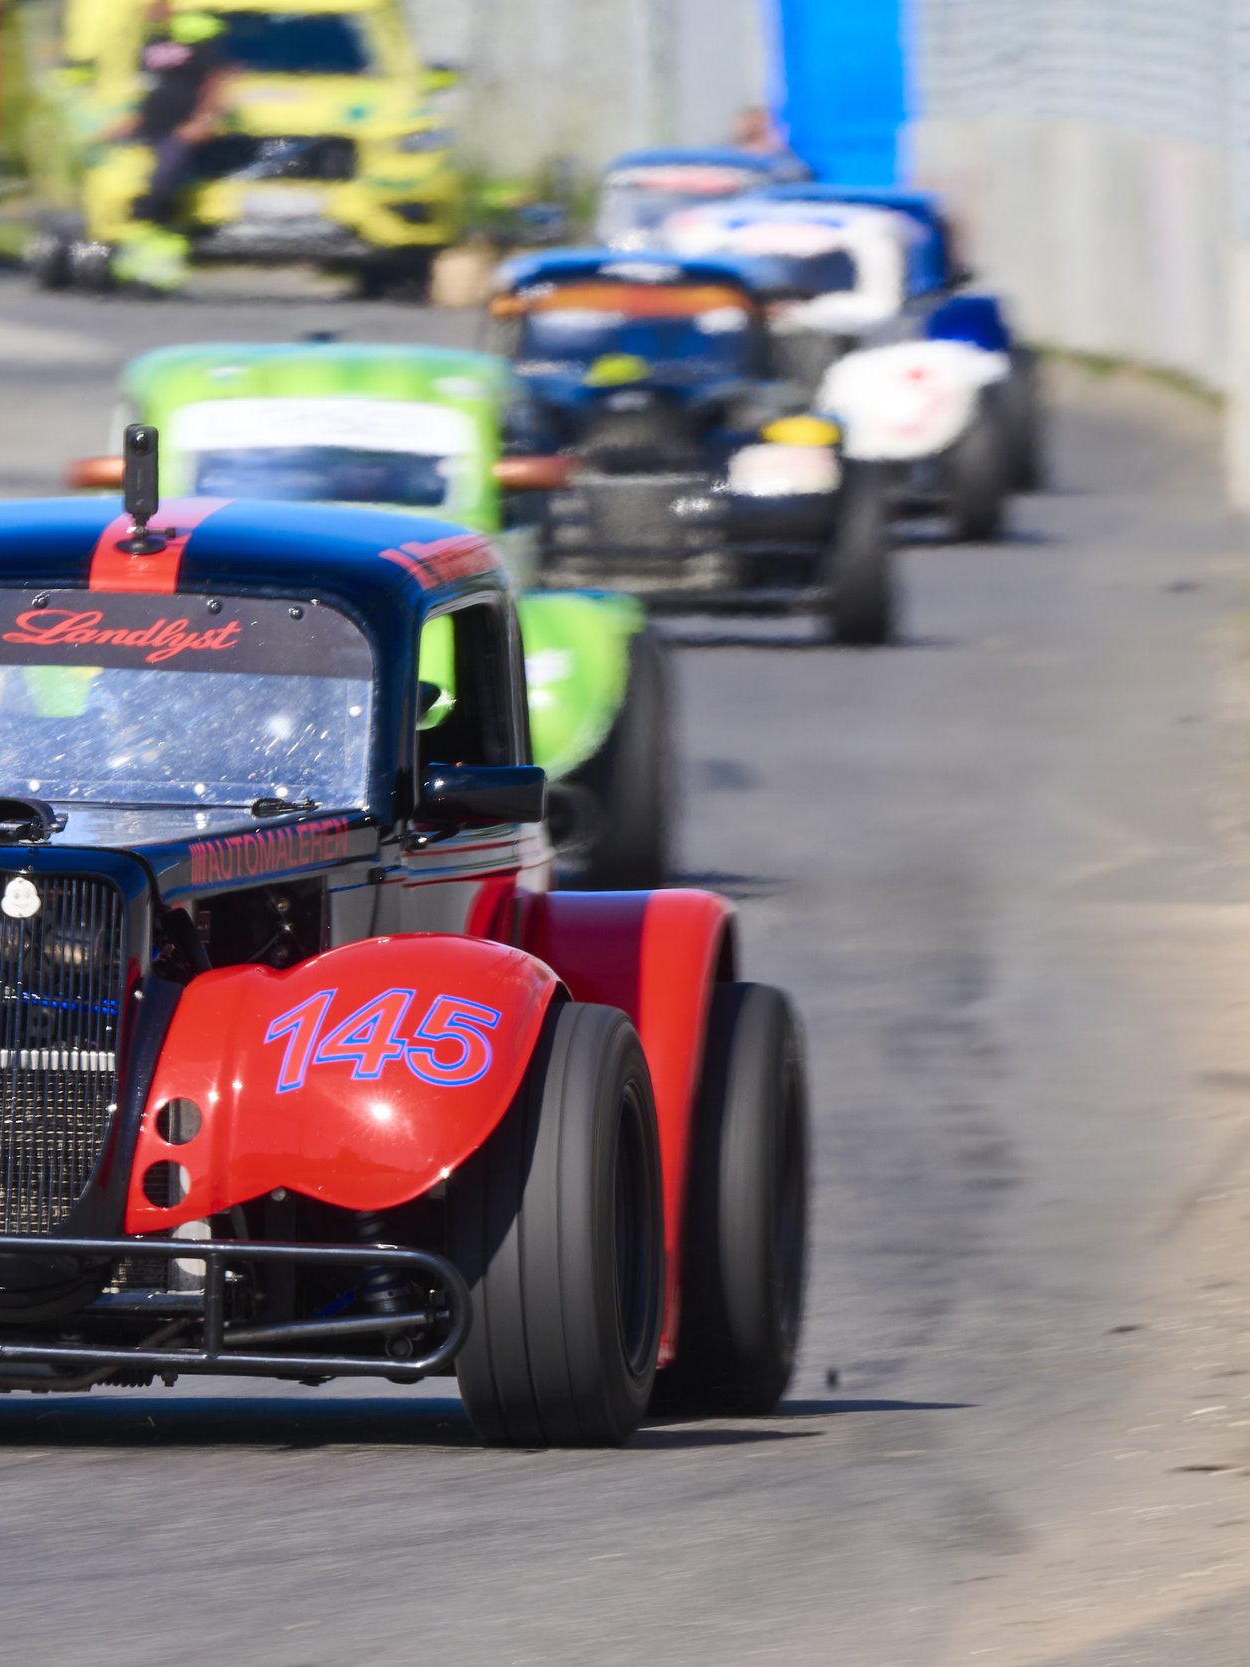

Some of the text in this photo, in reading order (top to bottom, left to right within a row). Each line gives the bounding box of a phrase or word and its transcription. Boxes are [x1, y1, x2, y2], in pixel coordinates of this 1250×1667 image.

[2, 609, 242, 662] Landlyst
[207, 817, 350, 883] AUTOMALEREN
[264, 988, 502, 1094] 145
